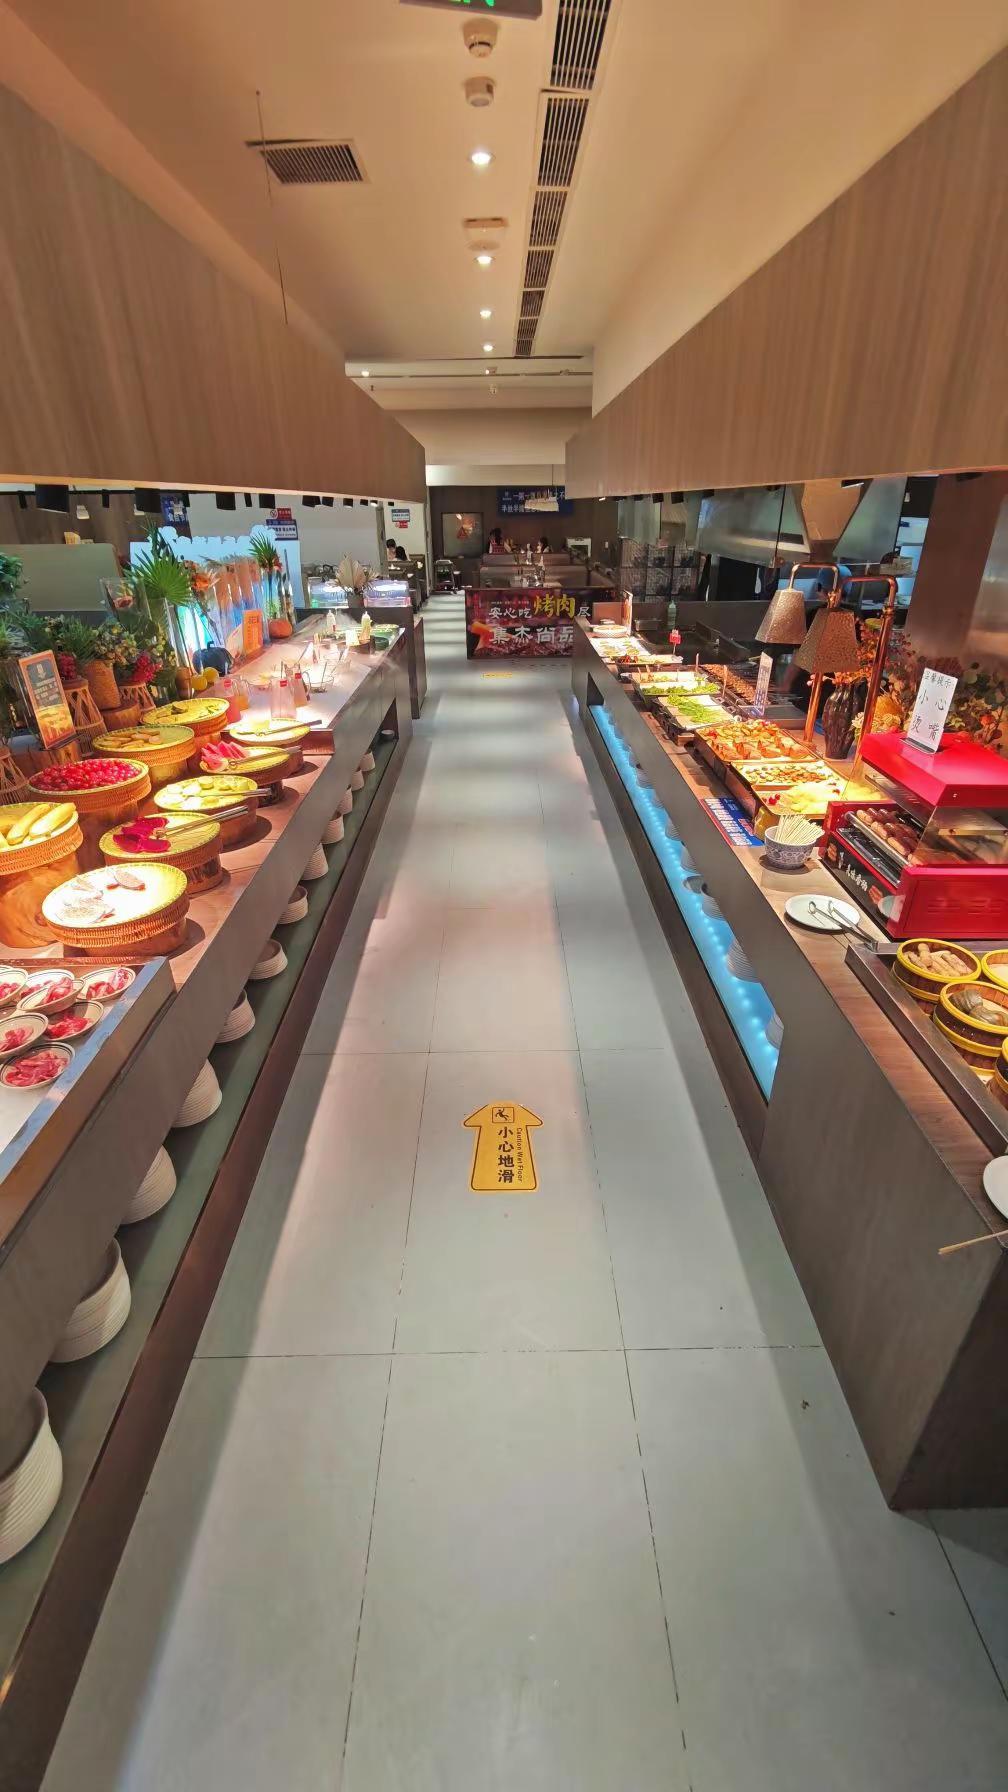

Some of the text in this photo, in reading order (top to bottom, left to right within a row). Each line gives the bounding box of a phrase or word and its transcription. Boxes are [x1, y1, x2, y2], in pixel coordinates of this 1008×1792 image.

[497, 1126, 515, 1184] 小心地滑
[516, 1151, 524, 1163] Wet
